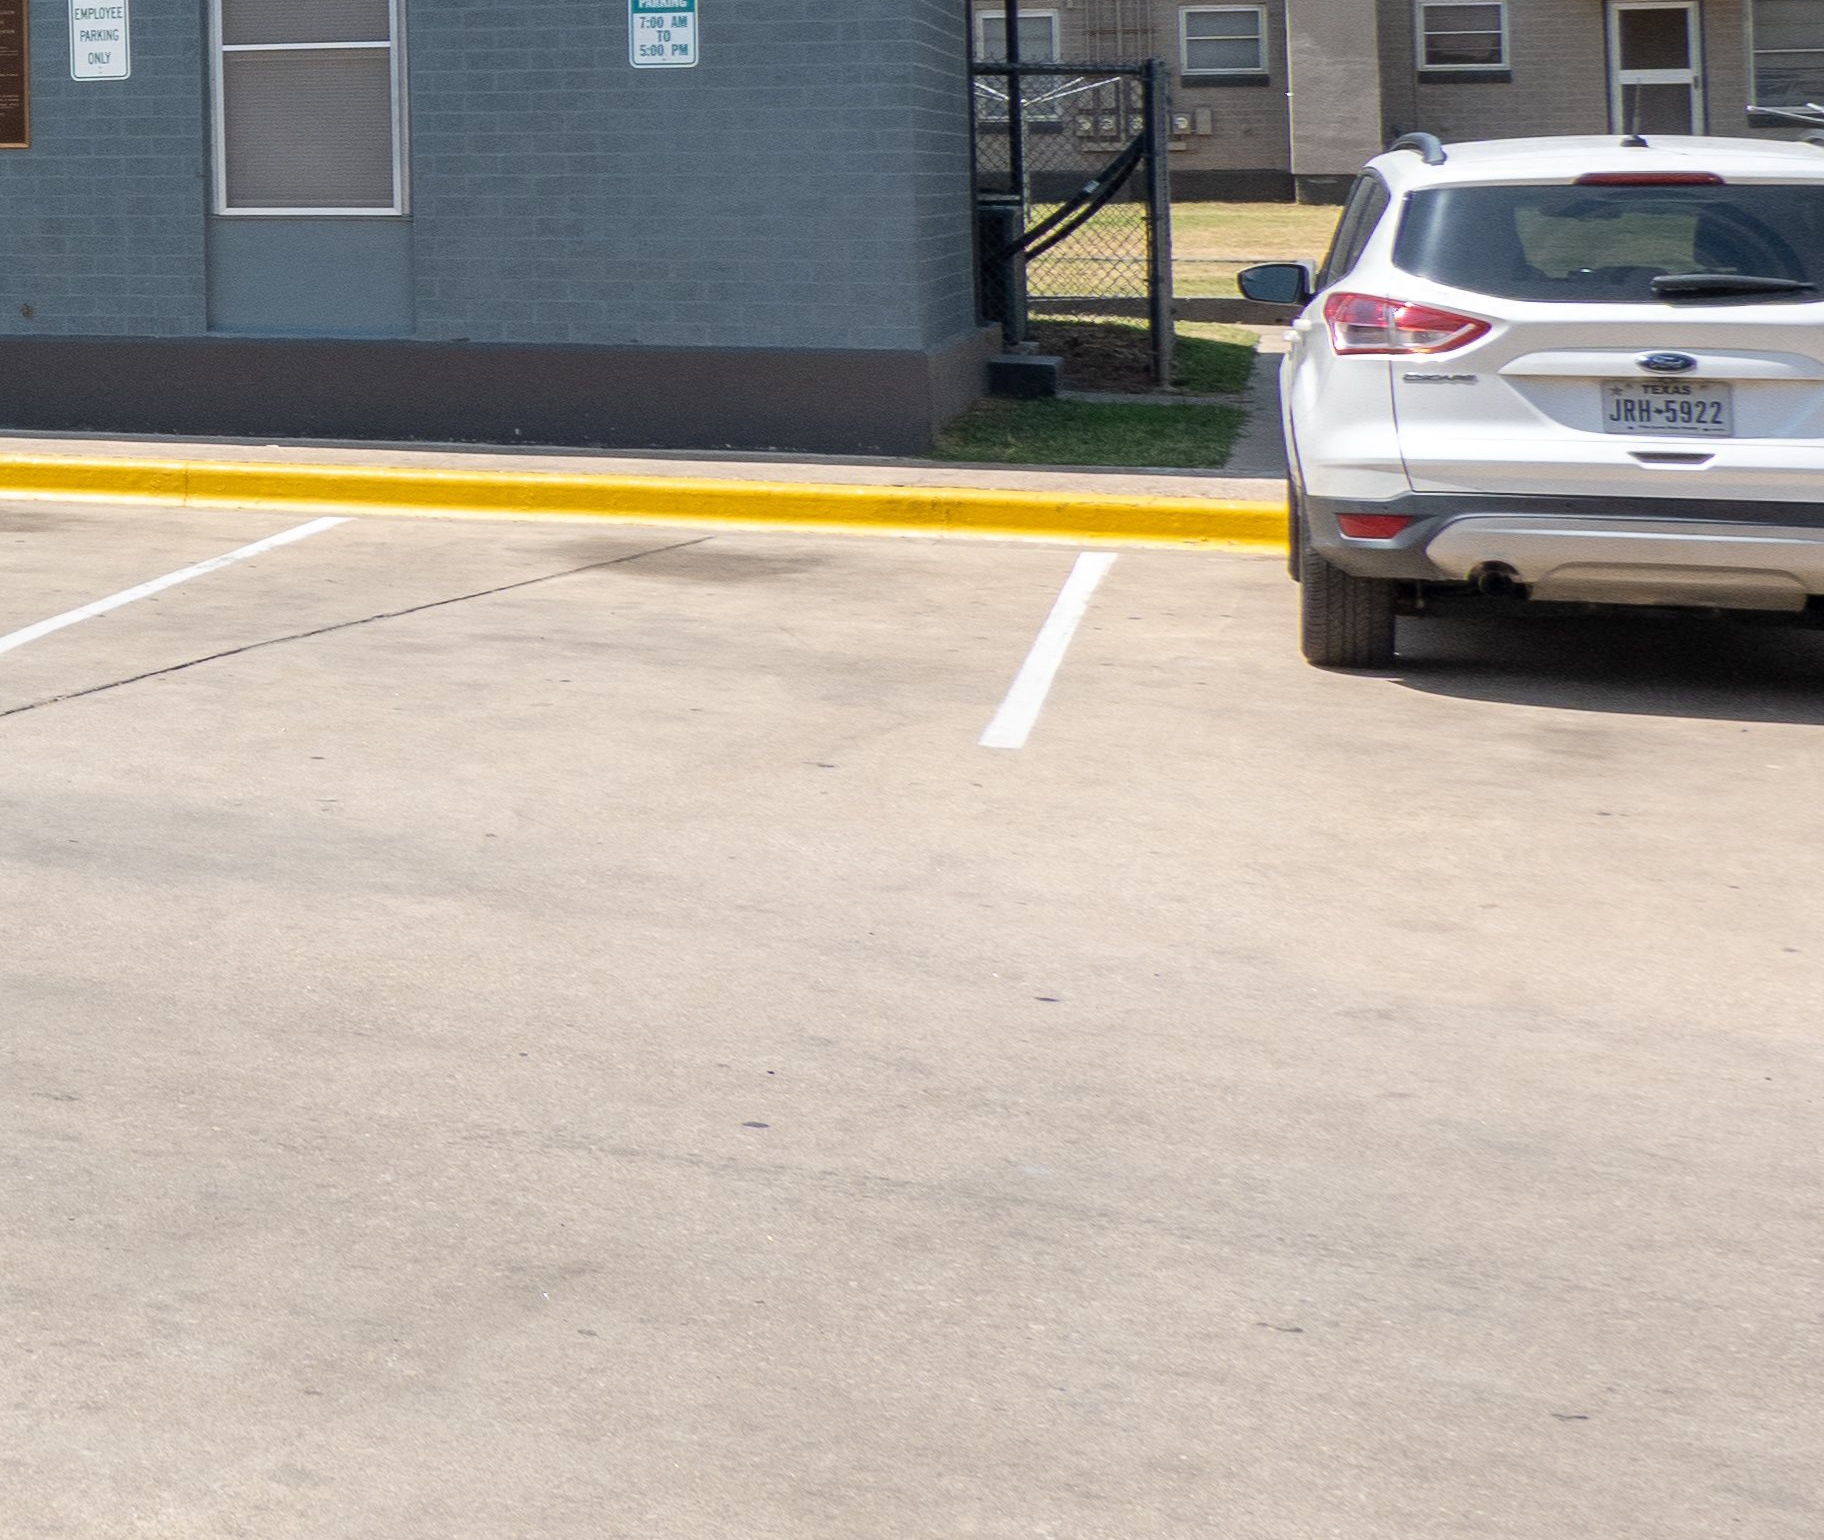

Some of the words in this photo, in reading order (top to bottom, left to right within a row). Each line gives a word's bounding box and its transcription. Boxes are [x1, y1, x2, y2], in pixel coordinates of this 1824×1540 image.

[74, 6, 123, 20] EMPLOYEE
[639, 16, 664, 29] 7:00
[671, 15, 688, 28] AM
[79, 28, 120, 42] PARKING
[656, 29, 671, 42] TO
[639, 44, 664, 57] 5:00
[671, 43, 688, 56] PM
[87, 51, 112, 65] ONLY
[1641, 384, 1692, 395] TEXAS
